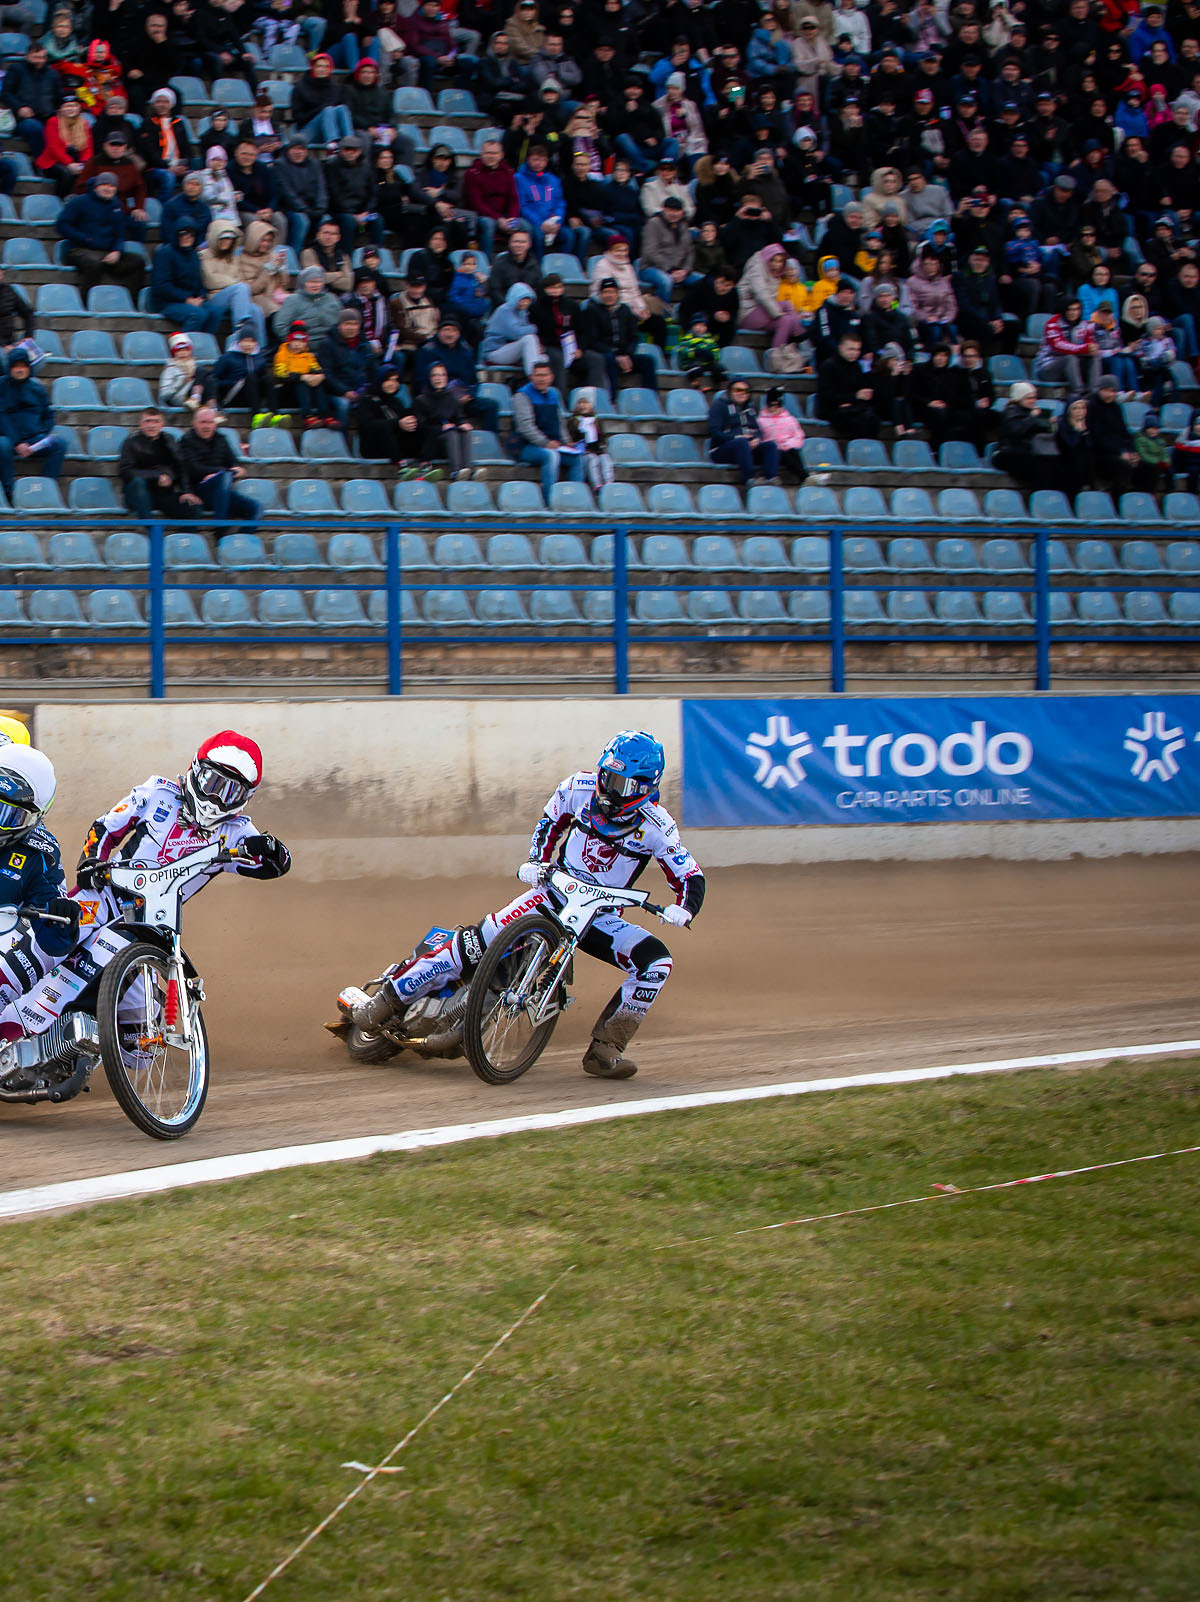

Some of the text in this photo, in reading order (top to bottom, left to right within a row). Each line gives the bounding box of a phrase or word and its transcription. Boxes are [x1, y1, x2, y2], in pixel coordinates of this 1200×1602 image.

[822, 721, 1033, 777] trodo
[954, 787, 1033, 806] ONLINE
[149, 866, 191, 883] OPTIBET
[578, 885, 617, 903] OPTIBET
[13, 949, 32, 971] AMBER
[408, 959, 451, 991] BarkerBille
[635, 989, 657, 1000] QNT
